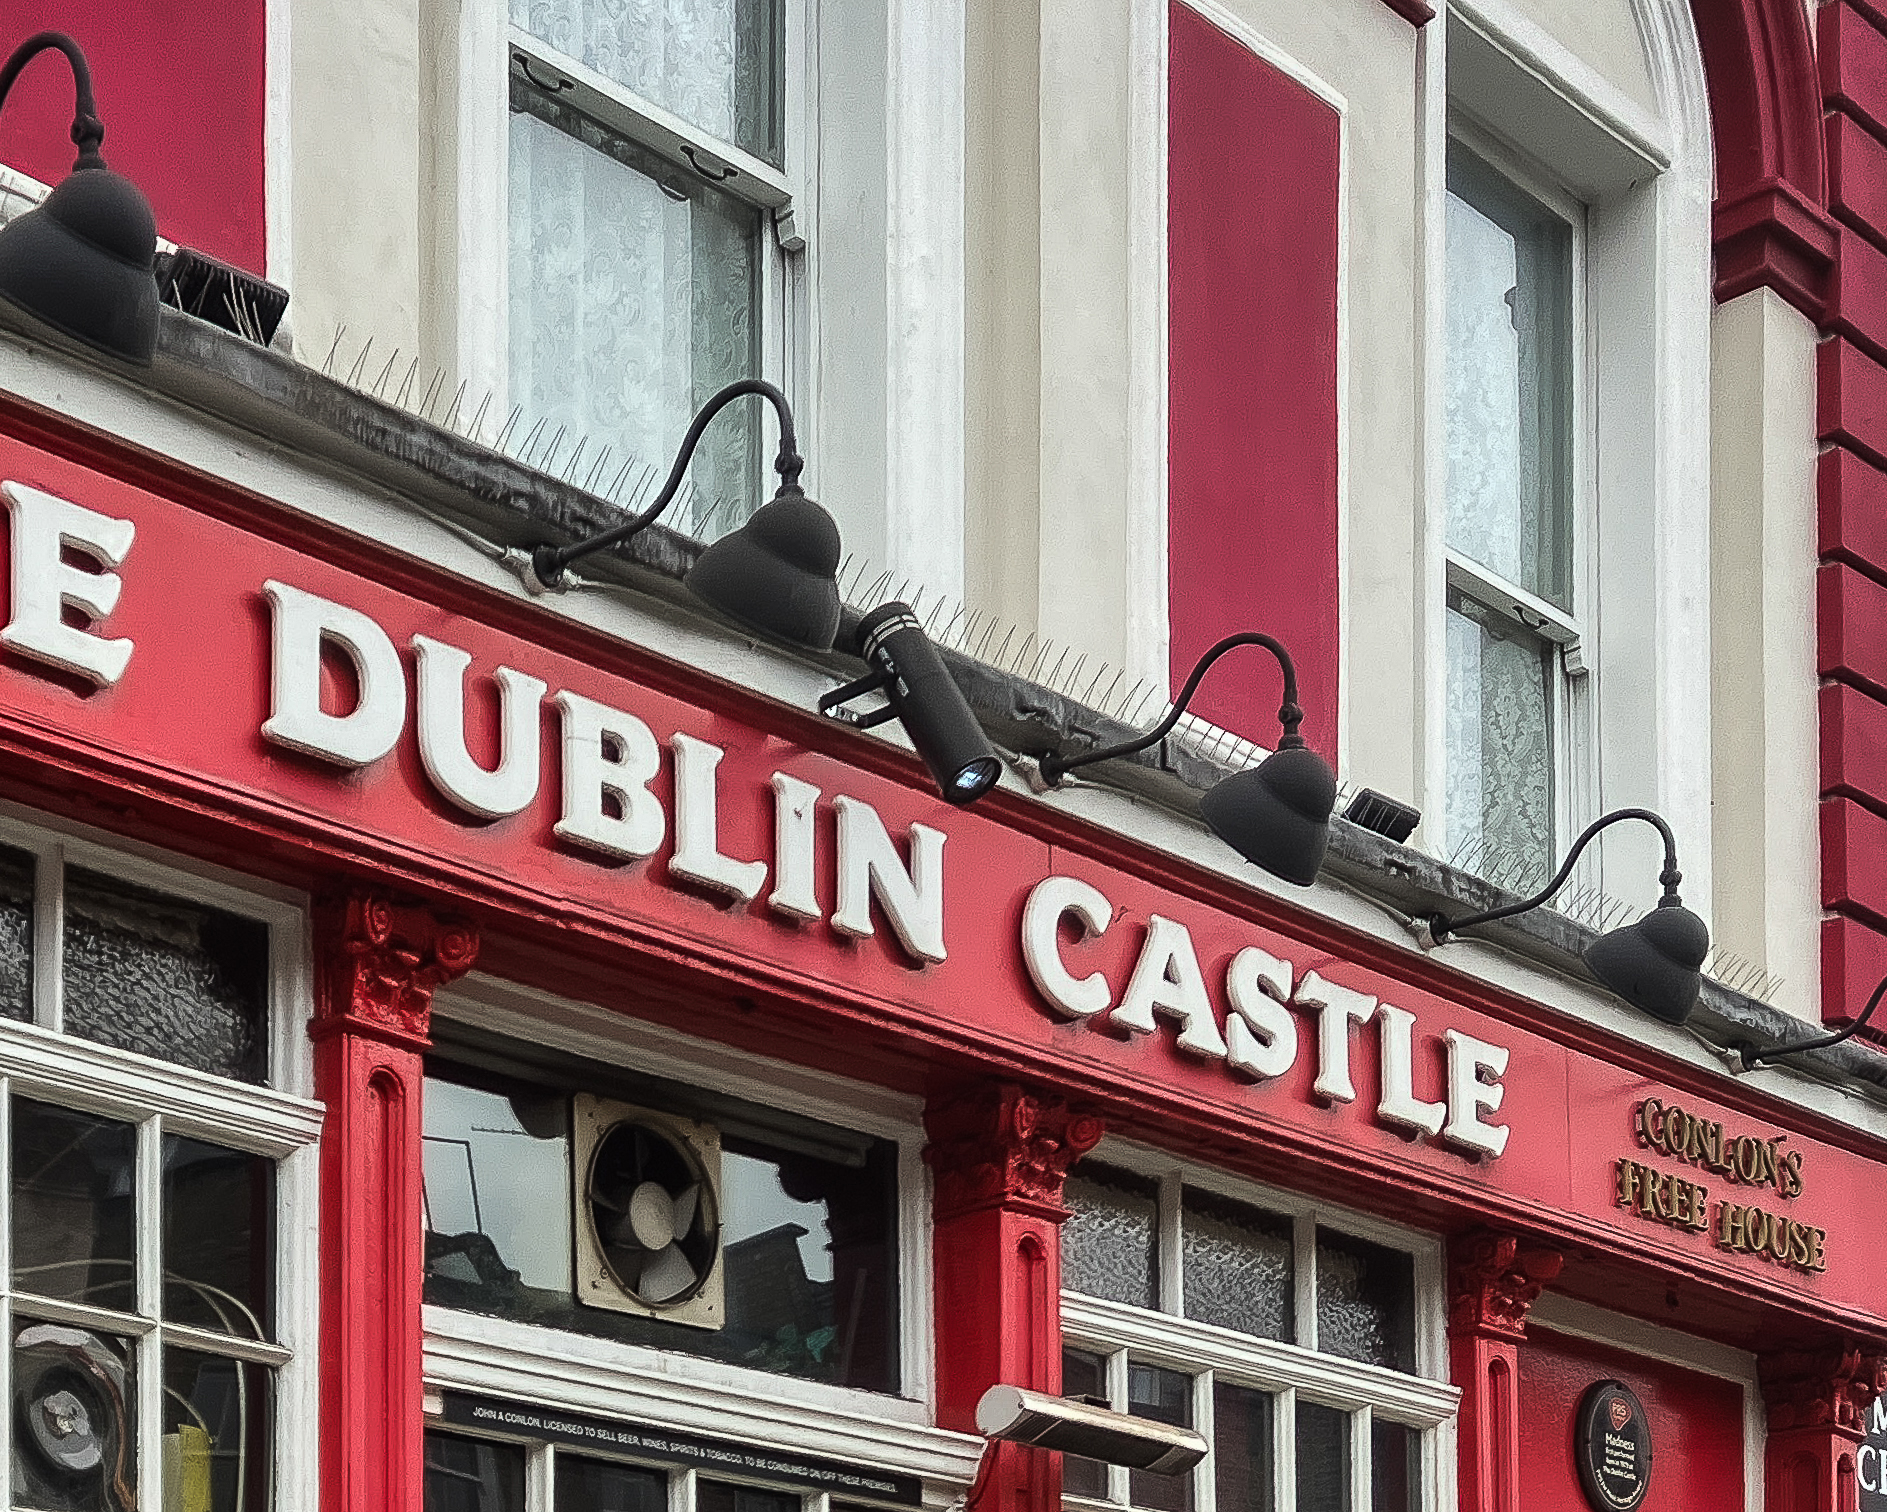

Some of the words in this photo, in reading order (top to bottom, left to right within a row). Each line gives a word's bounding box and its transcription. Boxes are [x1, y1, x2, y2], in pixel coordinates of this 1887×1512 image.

[260, 578, 949, 966] DUBLIN
[1021, 875, 1511, 1160] CASTLE
[1618, 1157, 1710, 1232] FREE
[1719, 1199, 1827, 1273] HOUSE
[472, 1406, 497, 1420] JOHN
[543, 1419, 584, 1436] LICENSED
[584, 1427, 596, 1438] TO
[596, 1429, 617, 1442] SELL
